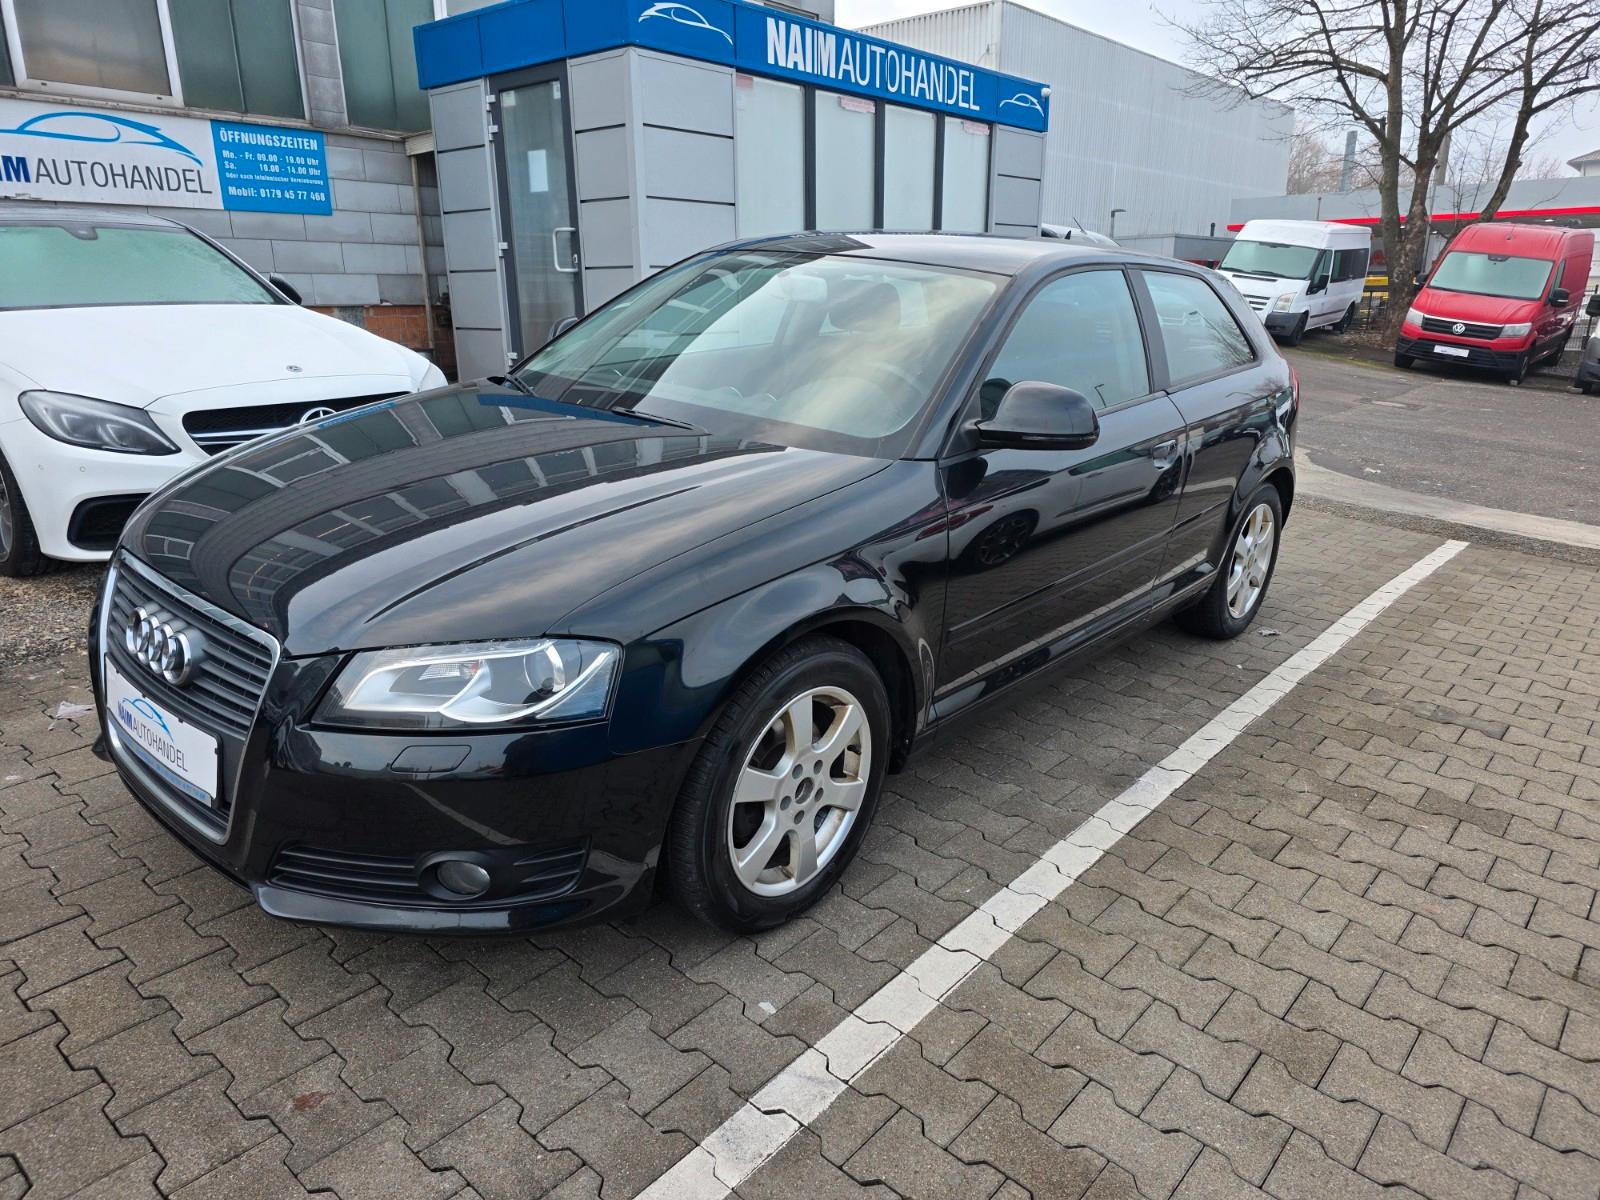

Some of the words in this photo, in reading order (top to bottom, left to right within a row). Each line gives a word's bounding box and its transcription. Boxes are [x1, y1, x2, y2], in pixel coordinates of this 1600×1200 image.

[766, 17, 836, 79] NAIM
[838, 38, 980, 111] AUTOHANDEL
[219, 127, 318, 151] ÖFFNUNGSZEITEN
[224, 161, 237, 170] Sa.
[308, 167, 321, 176] Uhr
[245, 152, 255, 161] Fr.
[306, 157, 319, 166] Uhr
[35, 157, 213, 194] AUTOHANDEL
[228, 186, 258, 197] Mobil:
[260, 188, 282, 199] 0179
[297, 190, 307, 200] 77
[117, 699, 133, 730] NAIM
[133, 716, 189, 773] AUTOHANDEL
